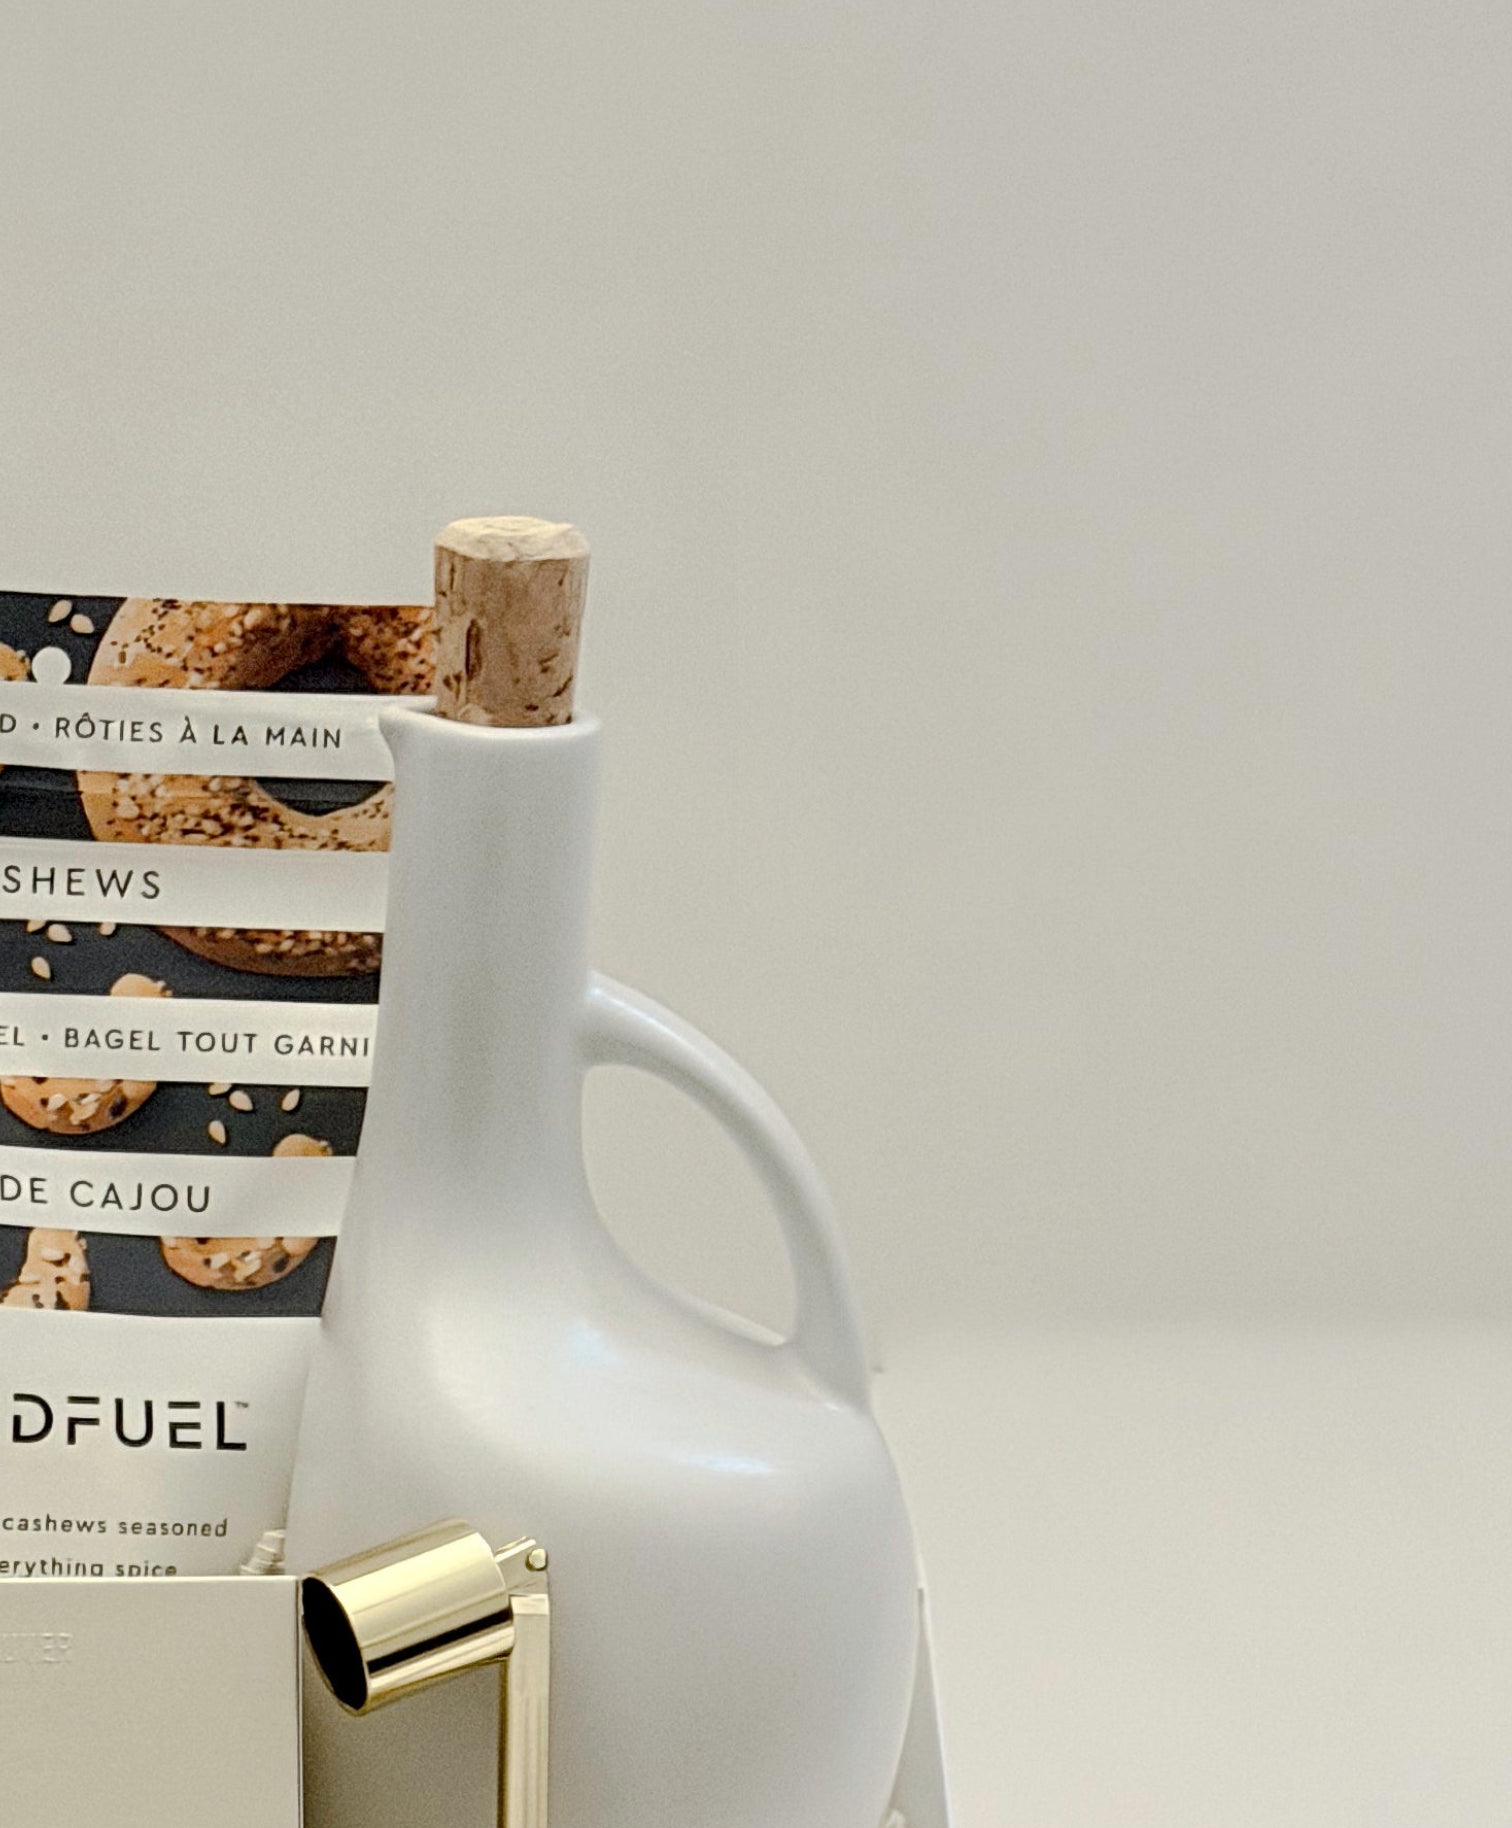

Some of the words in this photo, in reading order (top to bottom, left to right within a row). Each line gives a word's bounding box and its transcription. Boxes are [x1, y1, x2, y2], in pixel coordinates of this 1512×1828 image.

[55, 711, 163, 743] RÔTIES
[179, 715, 197, 744] À
[213, 724, 249, 746] LA
[265, 726, 341, 749] MAIN
[64, 1027, 161, 1051] BAGEL
[176, 1030, 258, 1054] TOUT
[273, 1034, 369, 1057] GARNI
[0, 1174, 48, 1205] DE
[69, 1180, 210, 1213] CAJOU
[2, 1513, 107, 1534] cashews
[118, 1517, 228, 1538] seasoned
